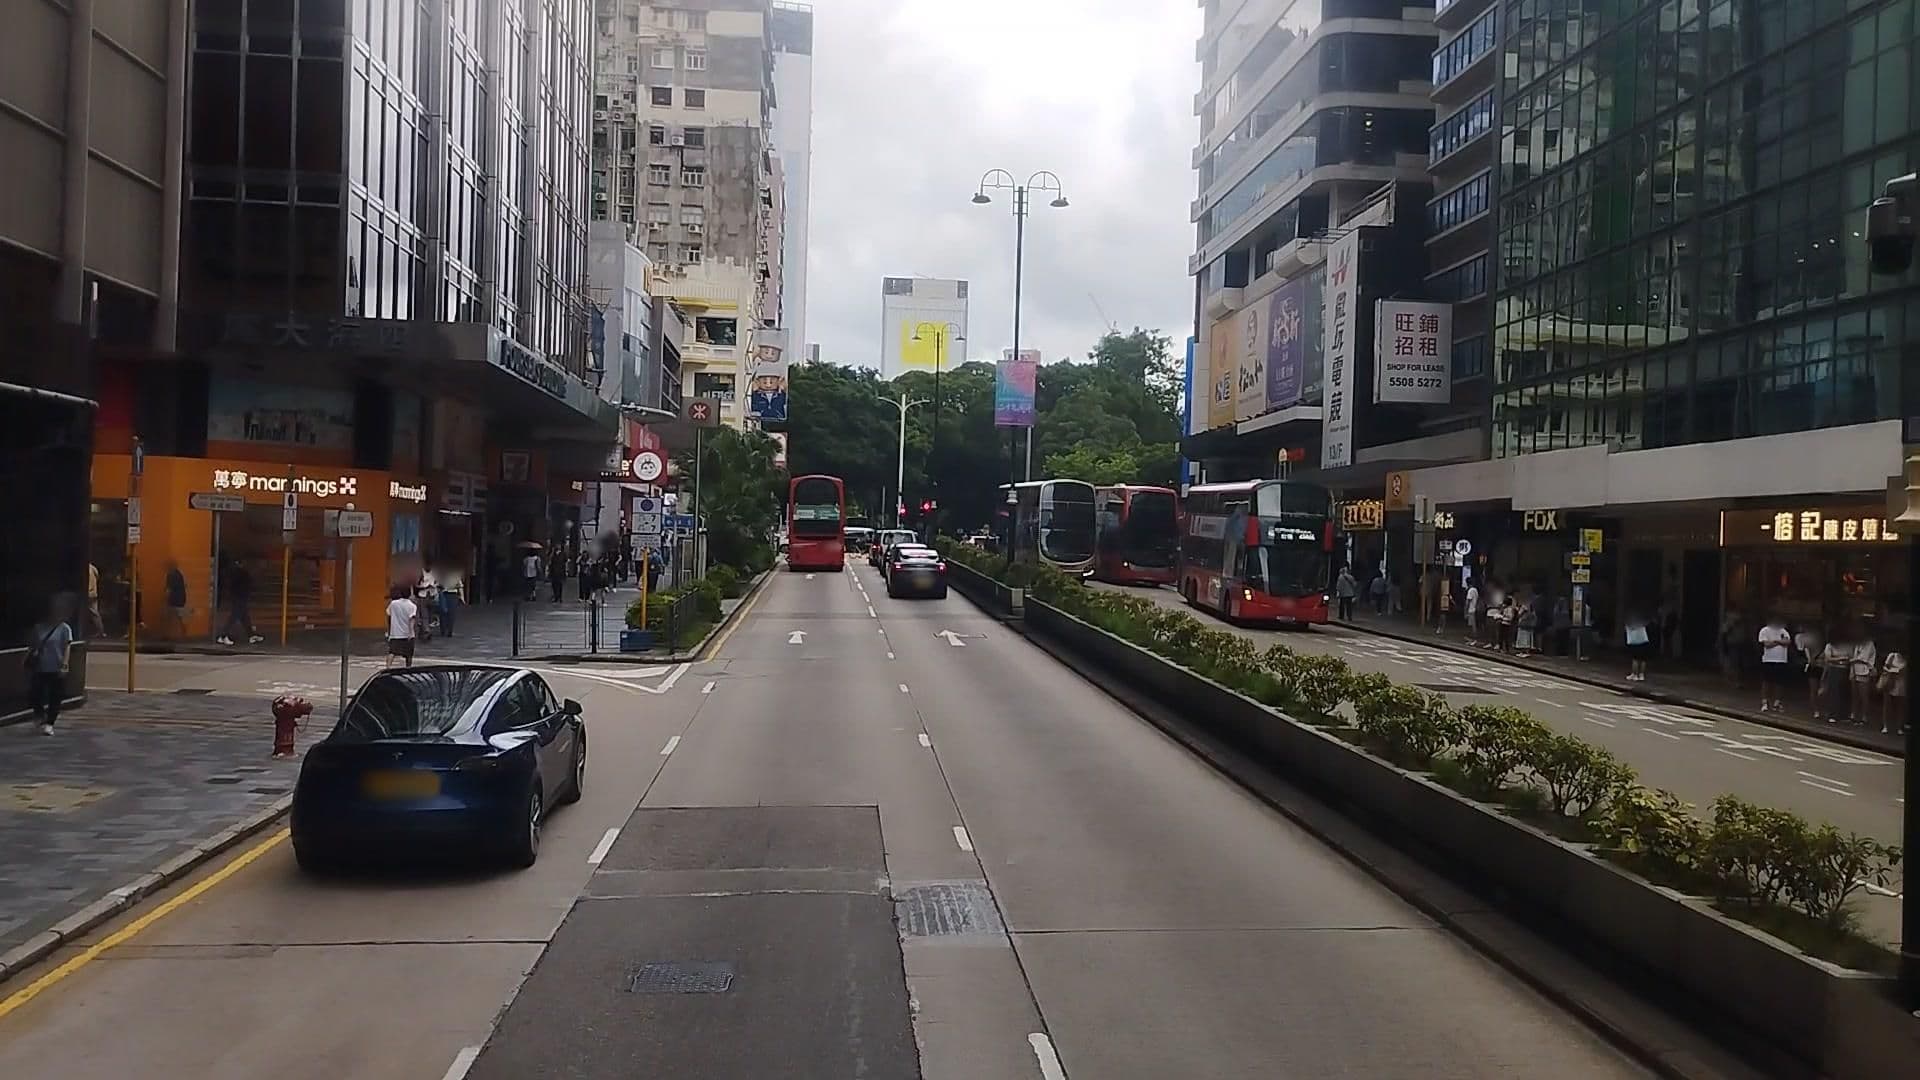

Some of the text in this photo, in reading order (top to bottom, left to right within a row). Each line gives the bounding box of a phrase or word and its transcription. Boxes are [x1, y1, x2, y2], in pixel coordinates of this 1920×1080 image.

[1395, 313, 1440, 334] 旺鋪
[1395, 336, 1439, 356] 招租
[1386, 363, 1406, 371] SHOP
[1423, 364, 1446, 372] LEASE
[1389, 377, 1442, 388] 5508 5272
[1524, 511, 1557, 530] FOX
